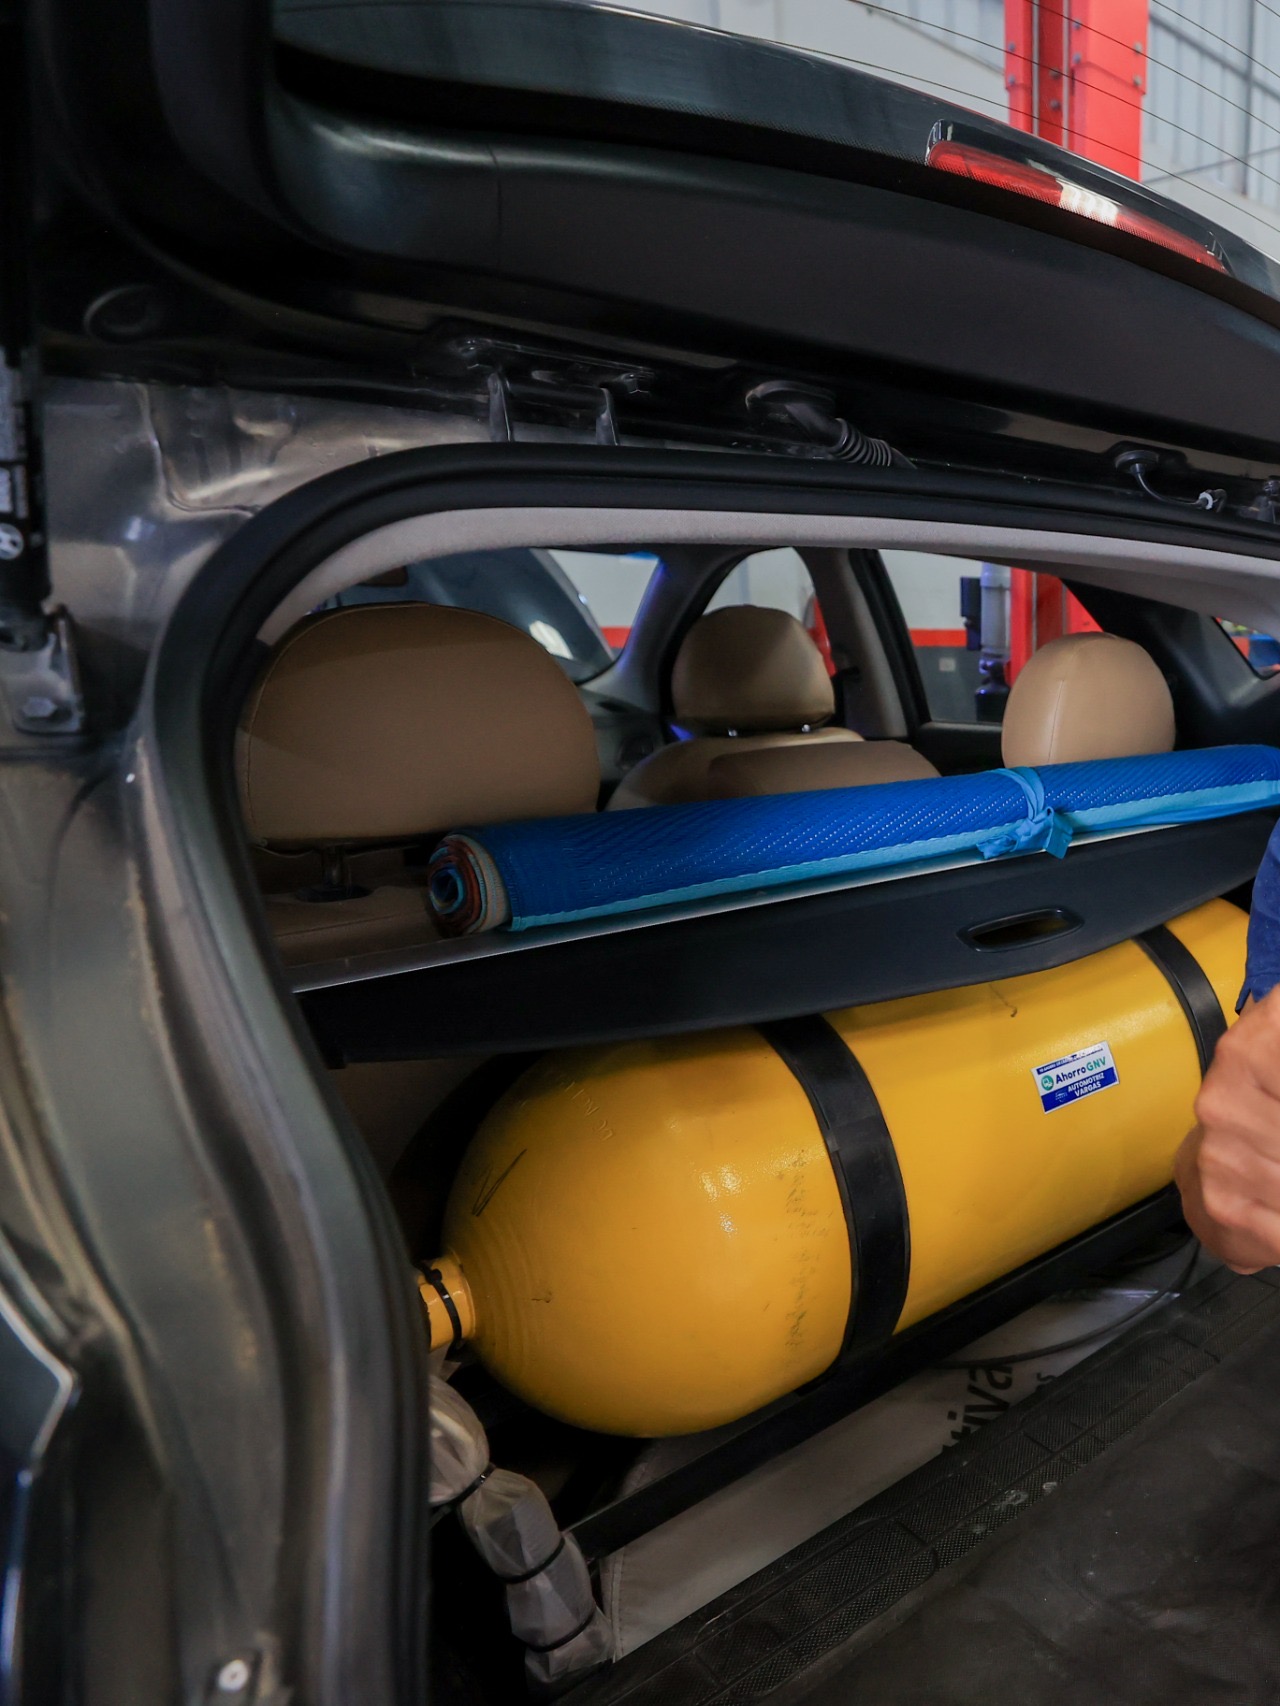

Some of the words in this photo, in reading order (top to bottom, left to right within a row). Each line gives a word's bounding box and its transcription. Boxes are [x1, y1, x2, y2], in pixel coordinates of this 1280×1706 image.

[1056, 1056, 1106, 1084] AhorroGNV
[1068, 1072, 1105, 1092] AUTOMOTRIZ
[1074, 1081, 1101, 1097] VARGAS
